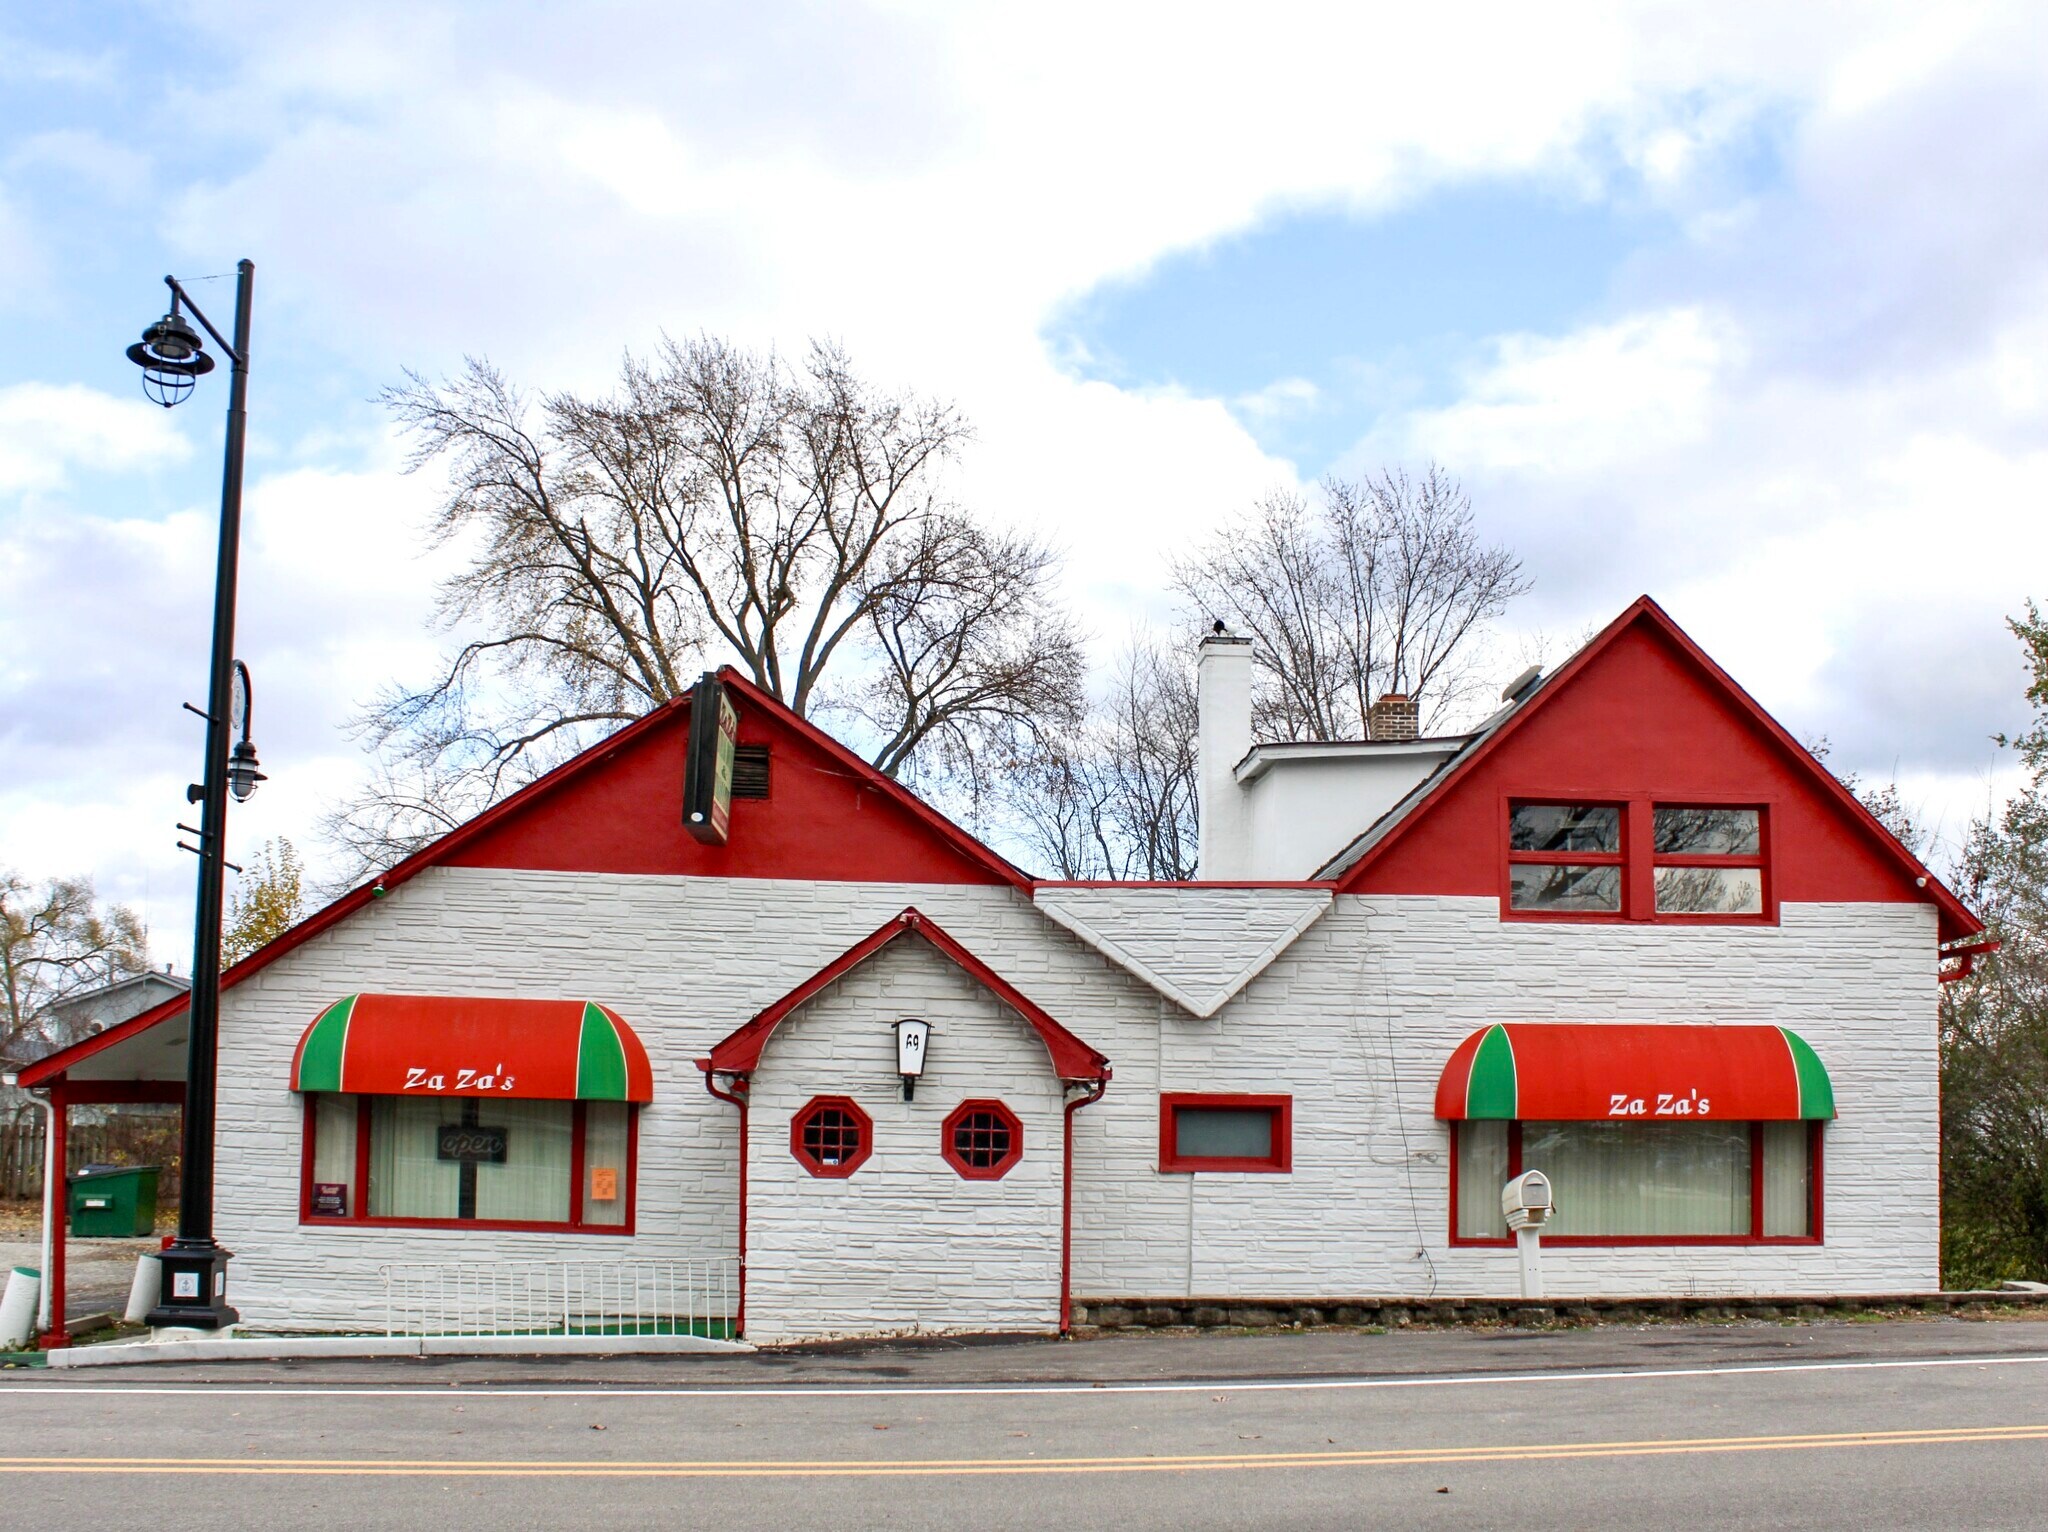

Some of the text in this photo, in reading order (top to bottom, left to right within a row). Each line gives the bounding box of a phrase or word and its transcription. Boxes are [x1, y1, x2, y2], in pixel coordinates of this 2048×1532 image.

[403, 1063, 515, 1091] Za Za's
[1608, 1088, 1710, 1116] Za Za's
[442, 1133, 504, 1158] open
